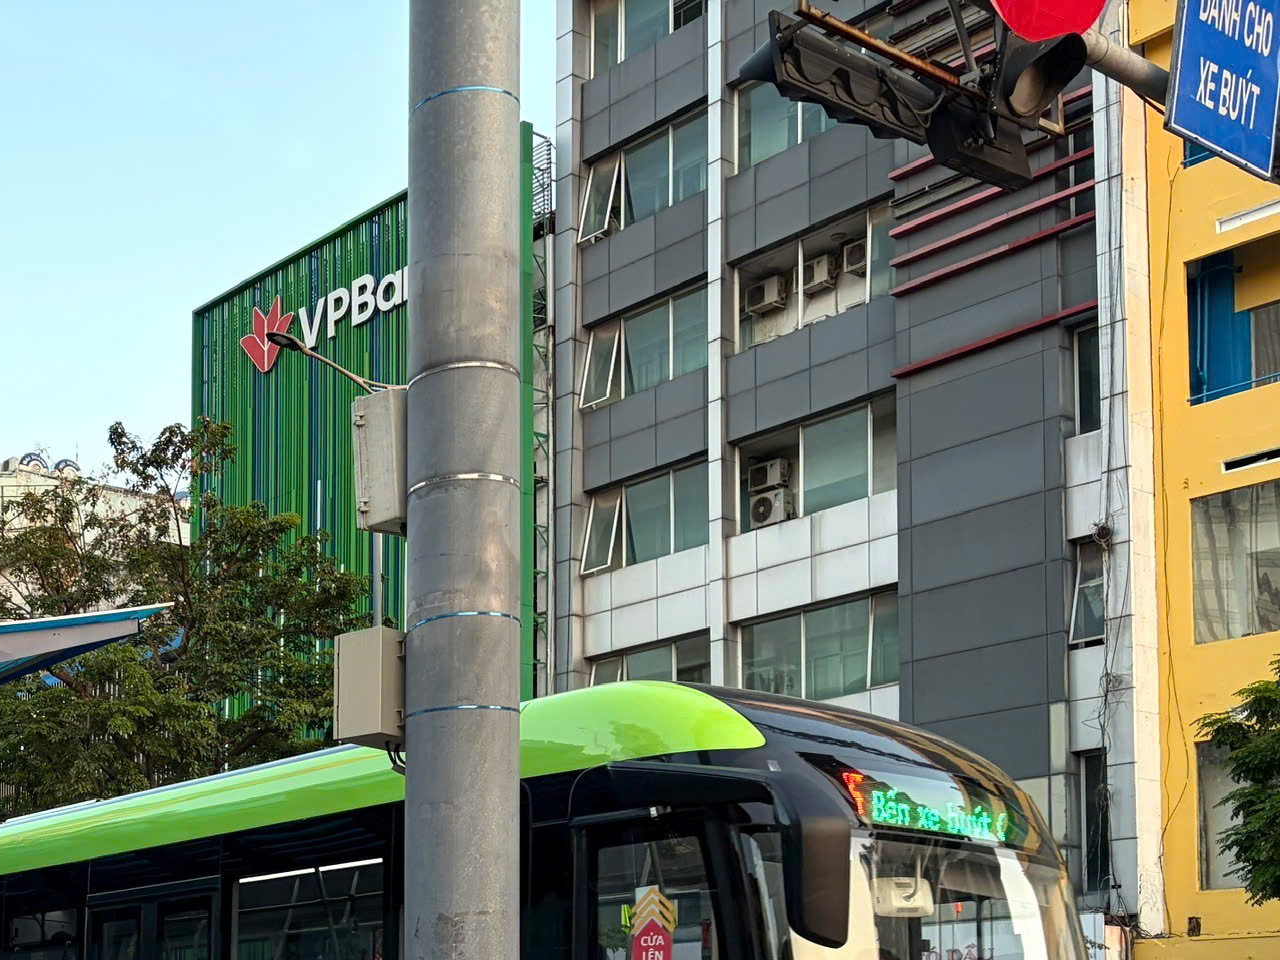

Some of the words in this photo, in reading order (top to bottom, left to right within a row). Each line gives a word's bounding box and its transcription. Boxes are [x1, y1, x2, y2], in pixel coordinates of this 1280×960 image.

[1243, 1, 1274, 57] CHO
[1195, 56, 1219, 110] XE
[1217, 68, 1261, 130] BUÝT
[871, 785, 912, 826] Bến
[917, 806, 942, 833] xe
[640, 932, 665, 946] CỬA
